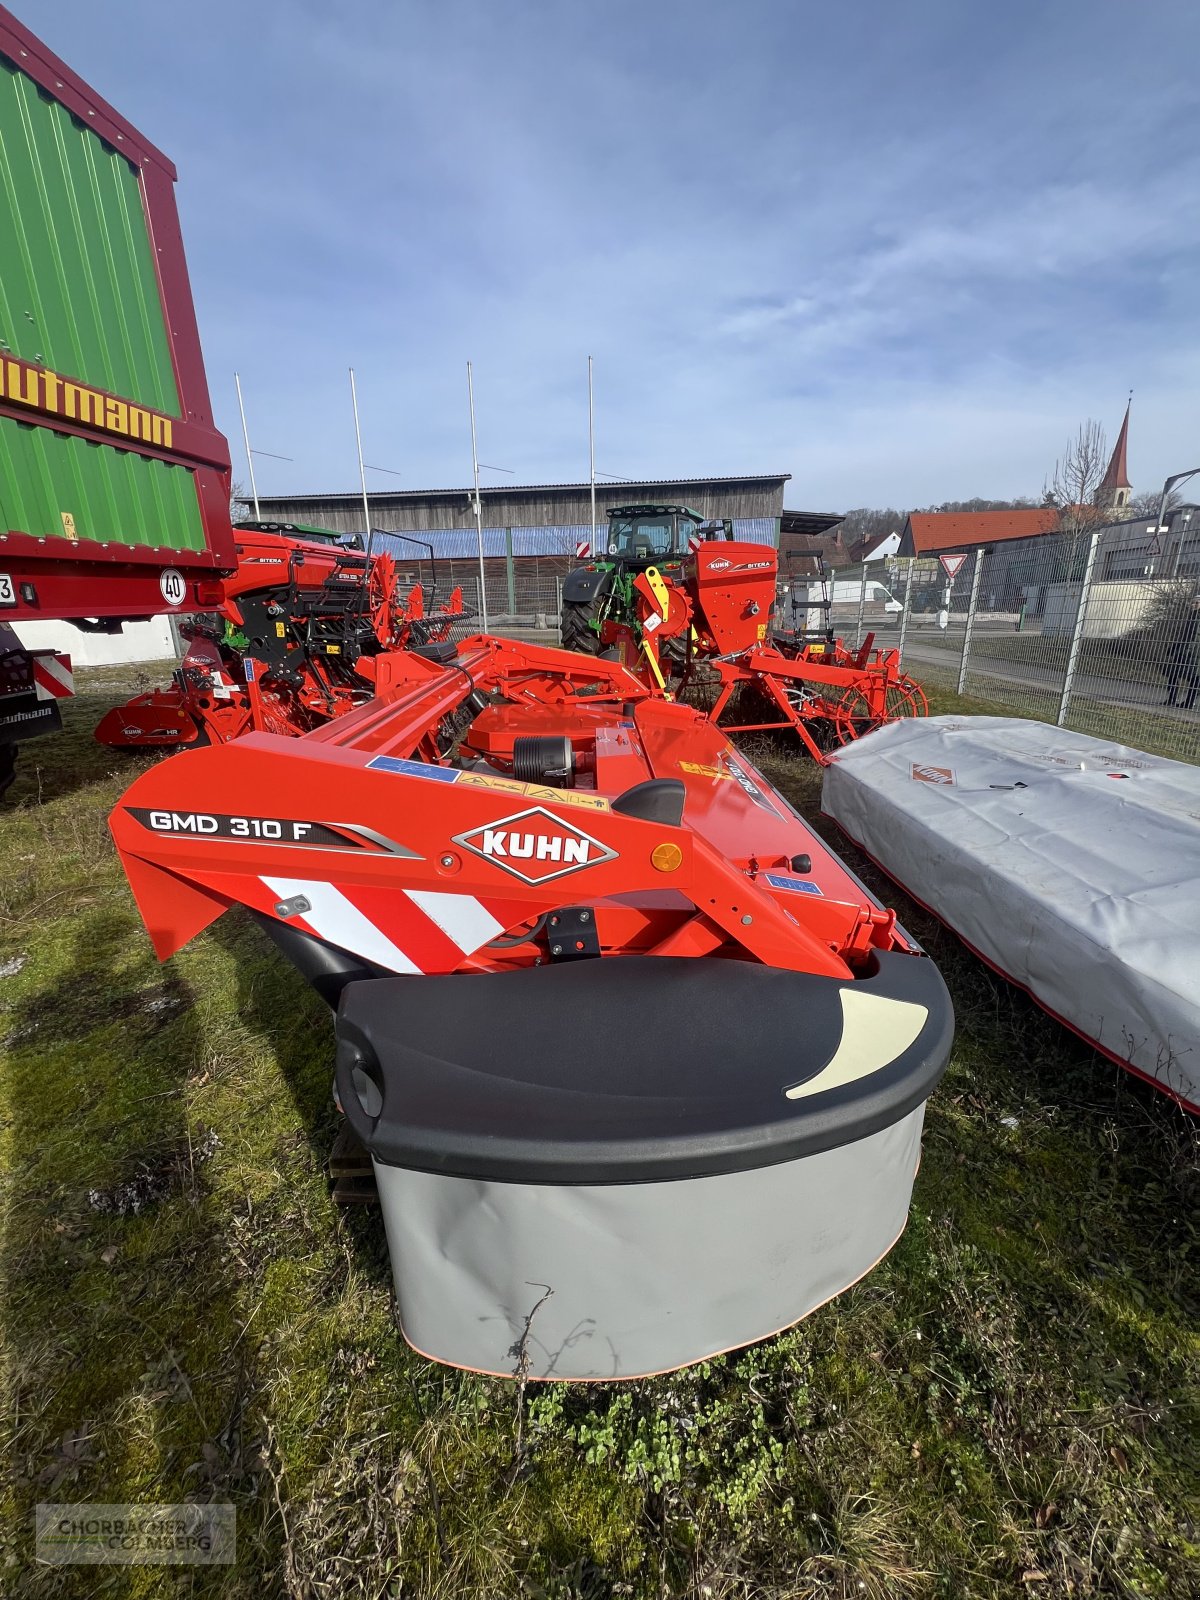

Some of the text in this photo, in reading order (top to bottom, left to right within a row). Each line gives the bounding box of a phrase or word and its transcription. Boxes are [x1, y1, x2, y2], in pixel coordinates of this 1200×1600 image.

[710, 561, 729, 569] KUHN
[165, 575, 180, 598] 40
[913, 764, 953, 784] KUHN
[150, 811, 312, 840] GMD 310 F
[482, 829, 590, 864] KUHN
